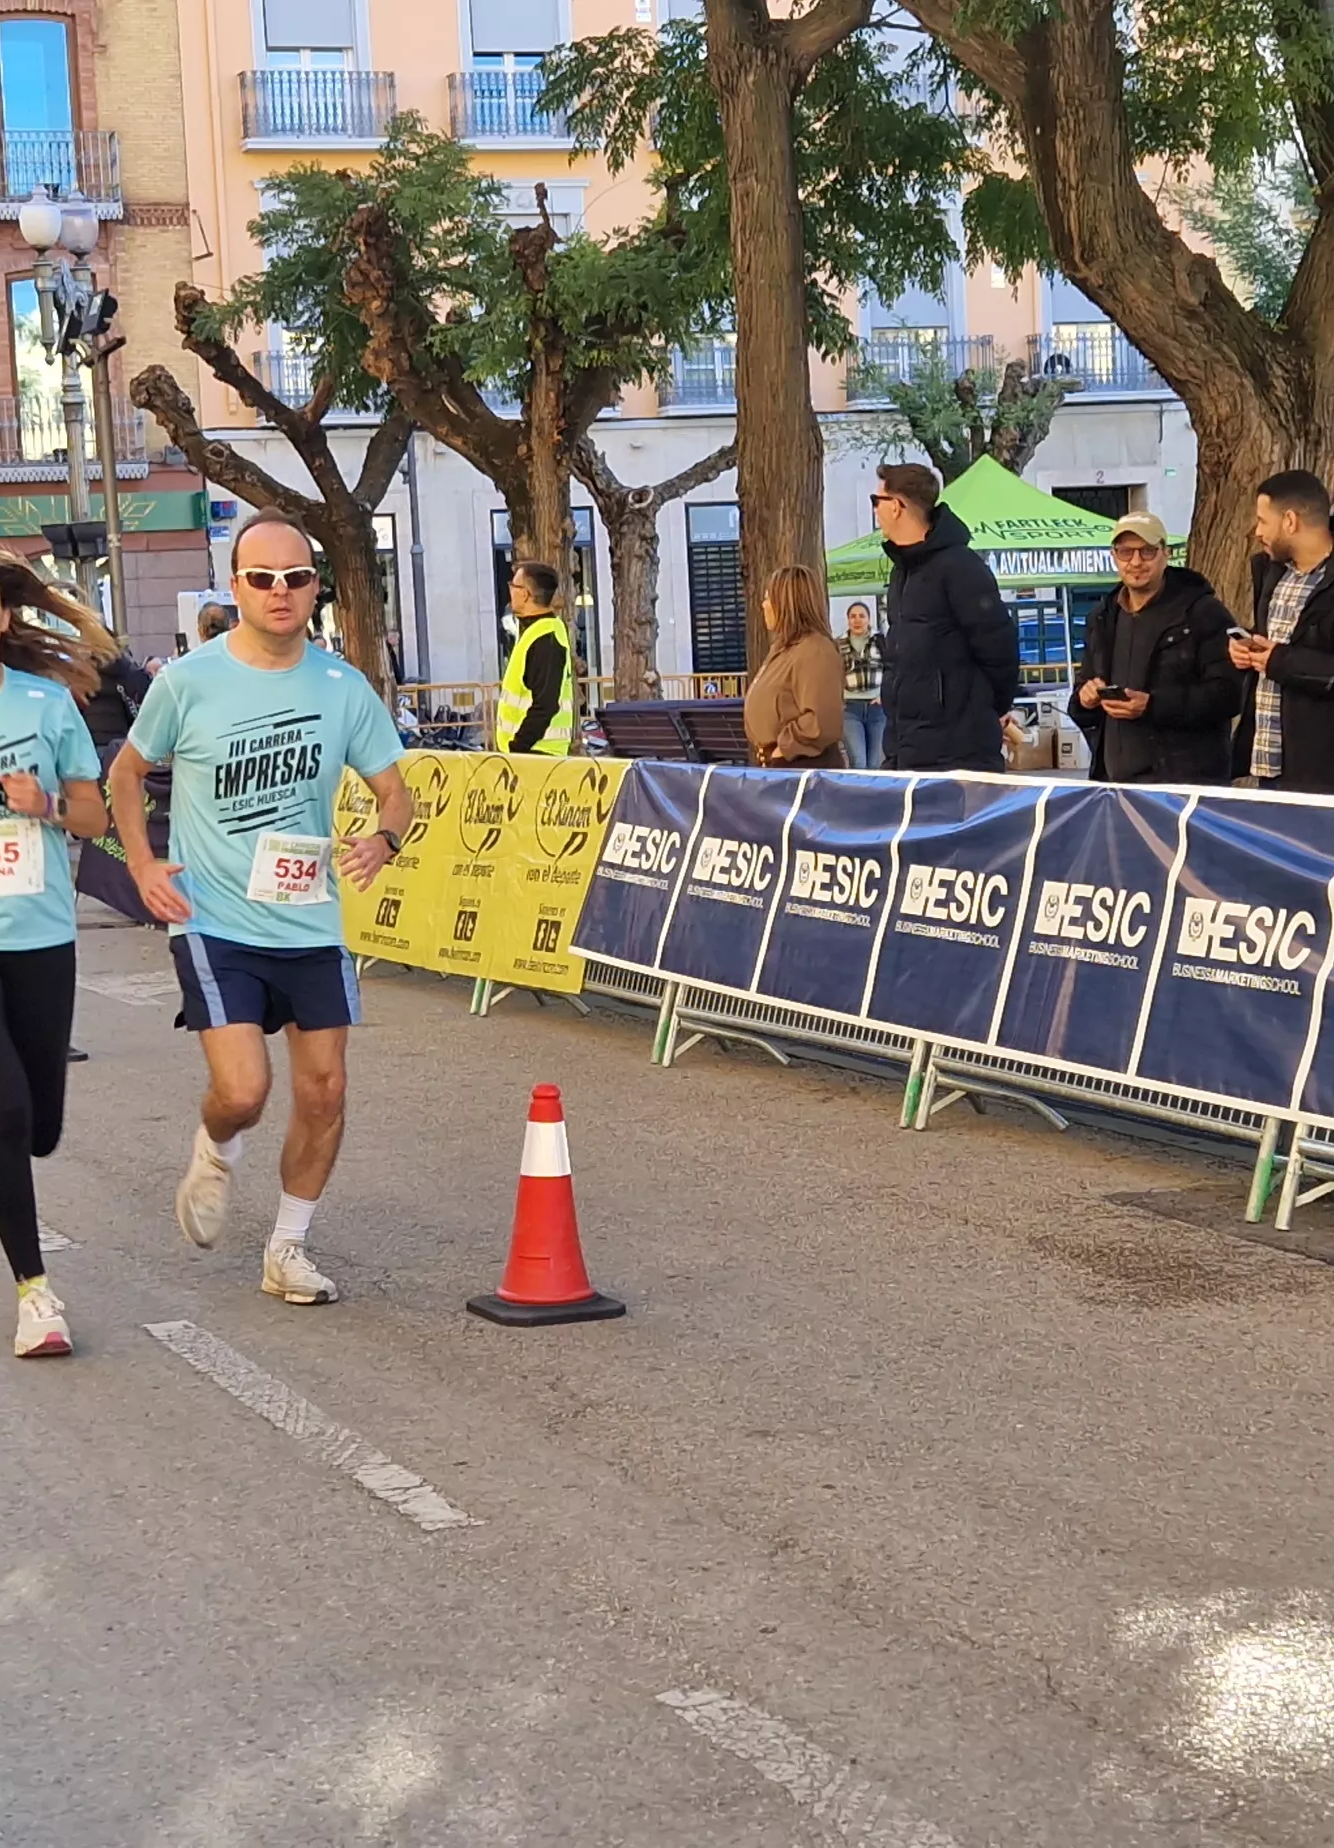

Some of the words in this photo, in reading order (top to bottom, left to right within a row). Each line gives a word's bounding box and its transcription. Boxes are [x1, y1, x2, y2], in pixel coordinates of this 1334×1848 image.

[1095, 470, 1105, 484] 2
[994, 517, 1088, 530] FARTLECK
[1010, 530, 1096, 541] SPORT
[228, 738, 247, 759] III
[249, 728, 303, 752] CARRERA
[214, 742, 323, 800] EMPRESAS
[231, 794, 255, 812] ESIC
[256, 786, 297, 807] HUESCA
[274, 857, 318, 881] 534
[622, 825, 681, 875] ESIC
[711, 839, 774, 892] ESIC
[277, 881, 310, 893] PABLO
[809, 853, 881, 909] ESIC
[924, 867, 1008, 928] ESIC
[1059, 883, 1151, 948] ESIC
[1209, 901, 1315, 971] ESIC
